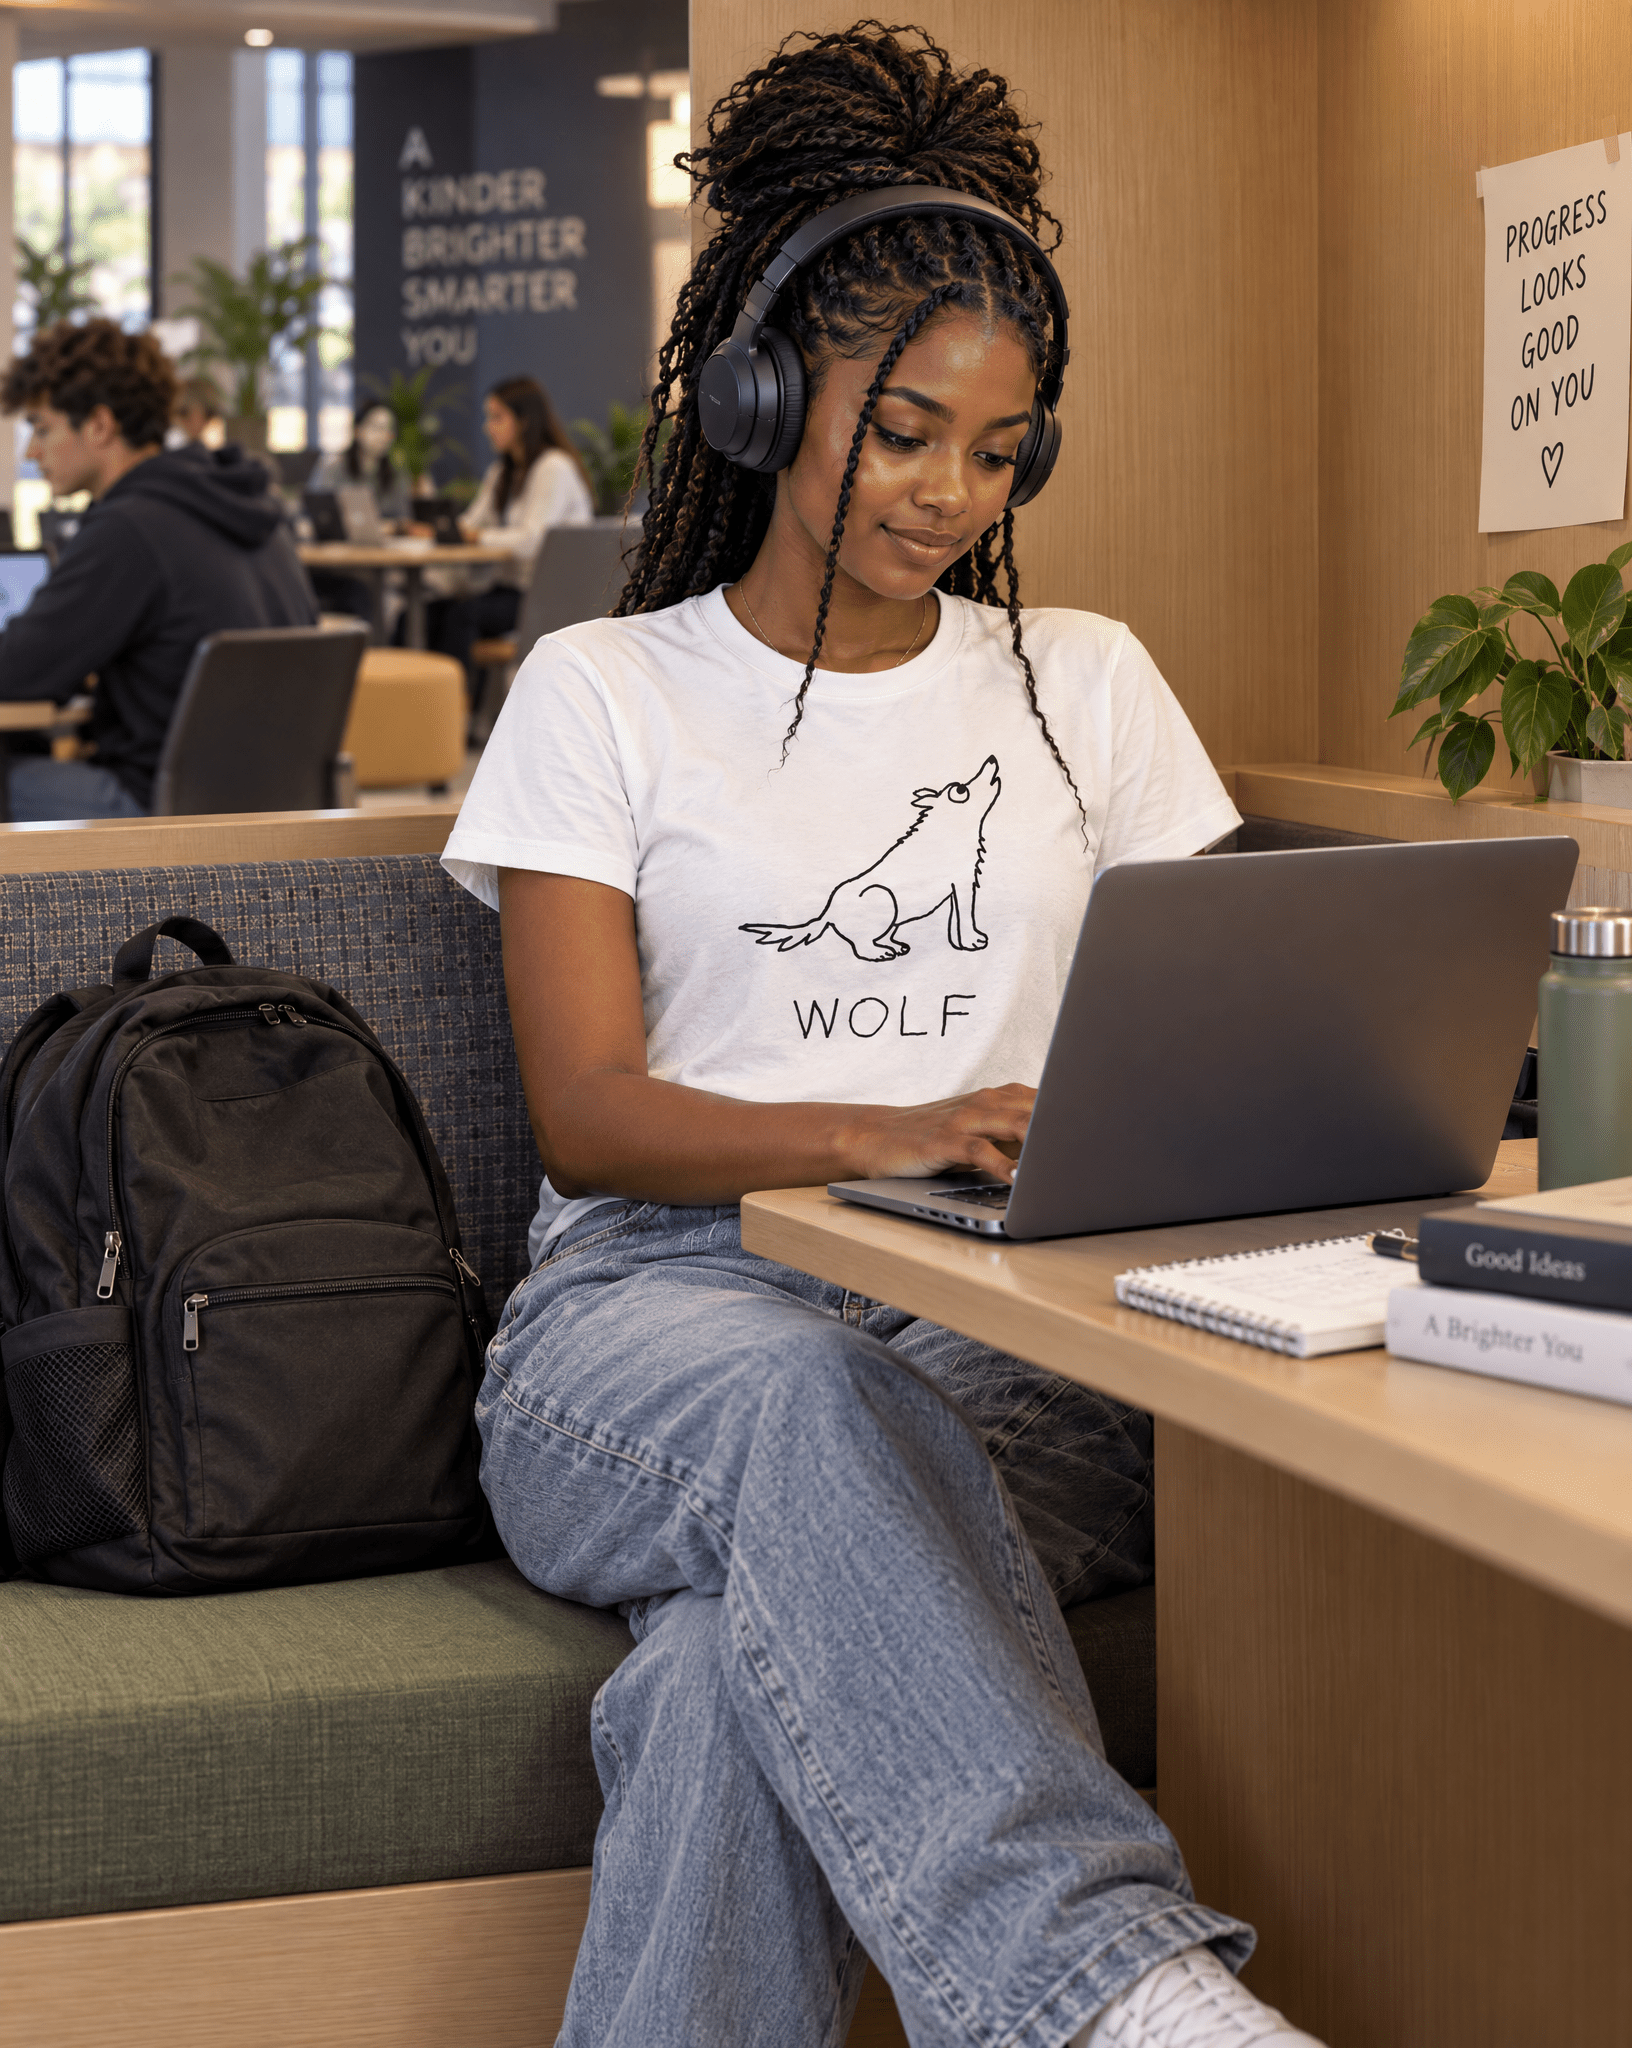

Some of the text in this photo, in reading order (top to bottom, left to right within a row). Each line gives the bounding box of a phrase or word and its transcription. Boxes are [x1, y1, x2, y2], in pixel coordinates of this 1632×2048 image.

[402, 126, 433, 168] A
[402, 169, 546, 217] KINDER
[403, 218, 586, 269] BRIGHTER
[1506, 189, 1607, 263] PROGRESS
[402, 269, 578, 319] SMARTER
[1521, 253, 1586, 313] LOOKS
[402, 327, 478, 366] YOU
[1521, 314, 1579, 369] GOOD
[1510, 363, 1595, 432] ON YOU
[793, 994, 977, 1040] WOLF
[1465, 1242, 1586, 1282] Good Ideas
[1423, 1314, 1584, 1363] A Brighter You
